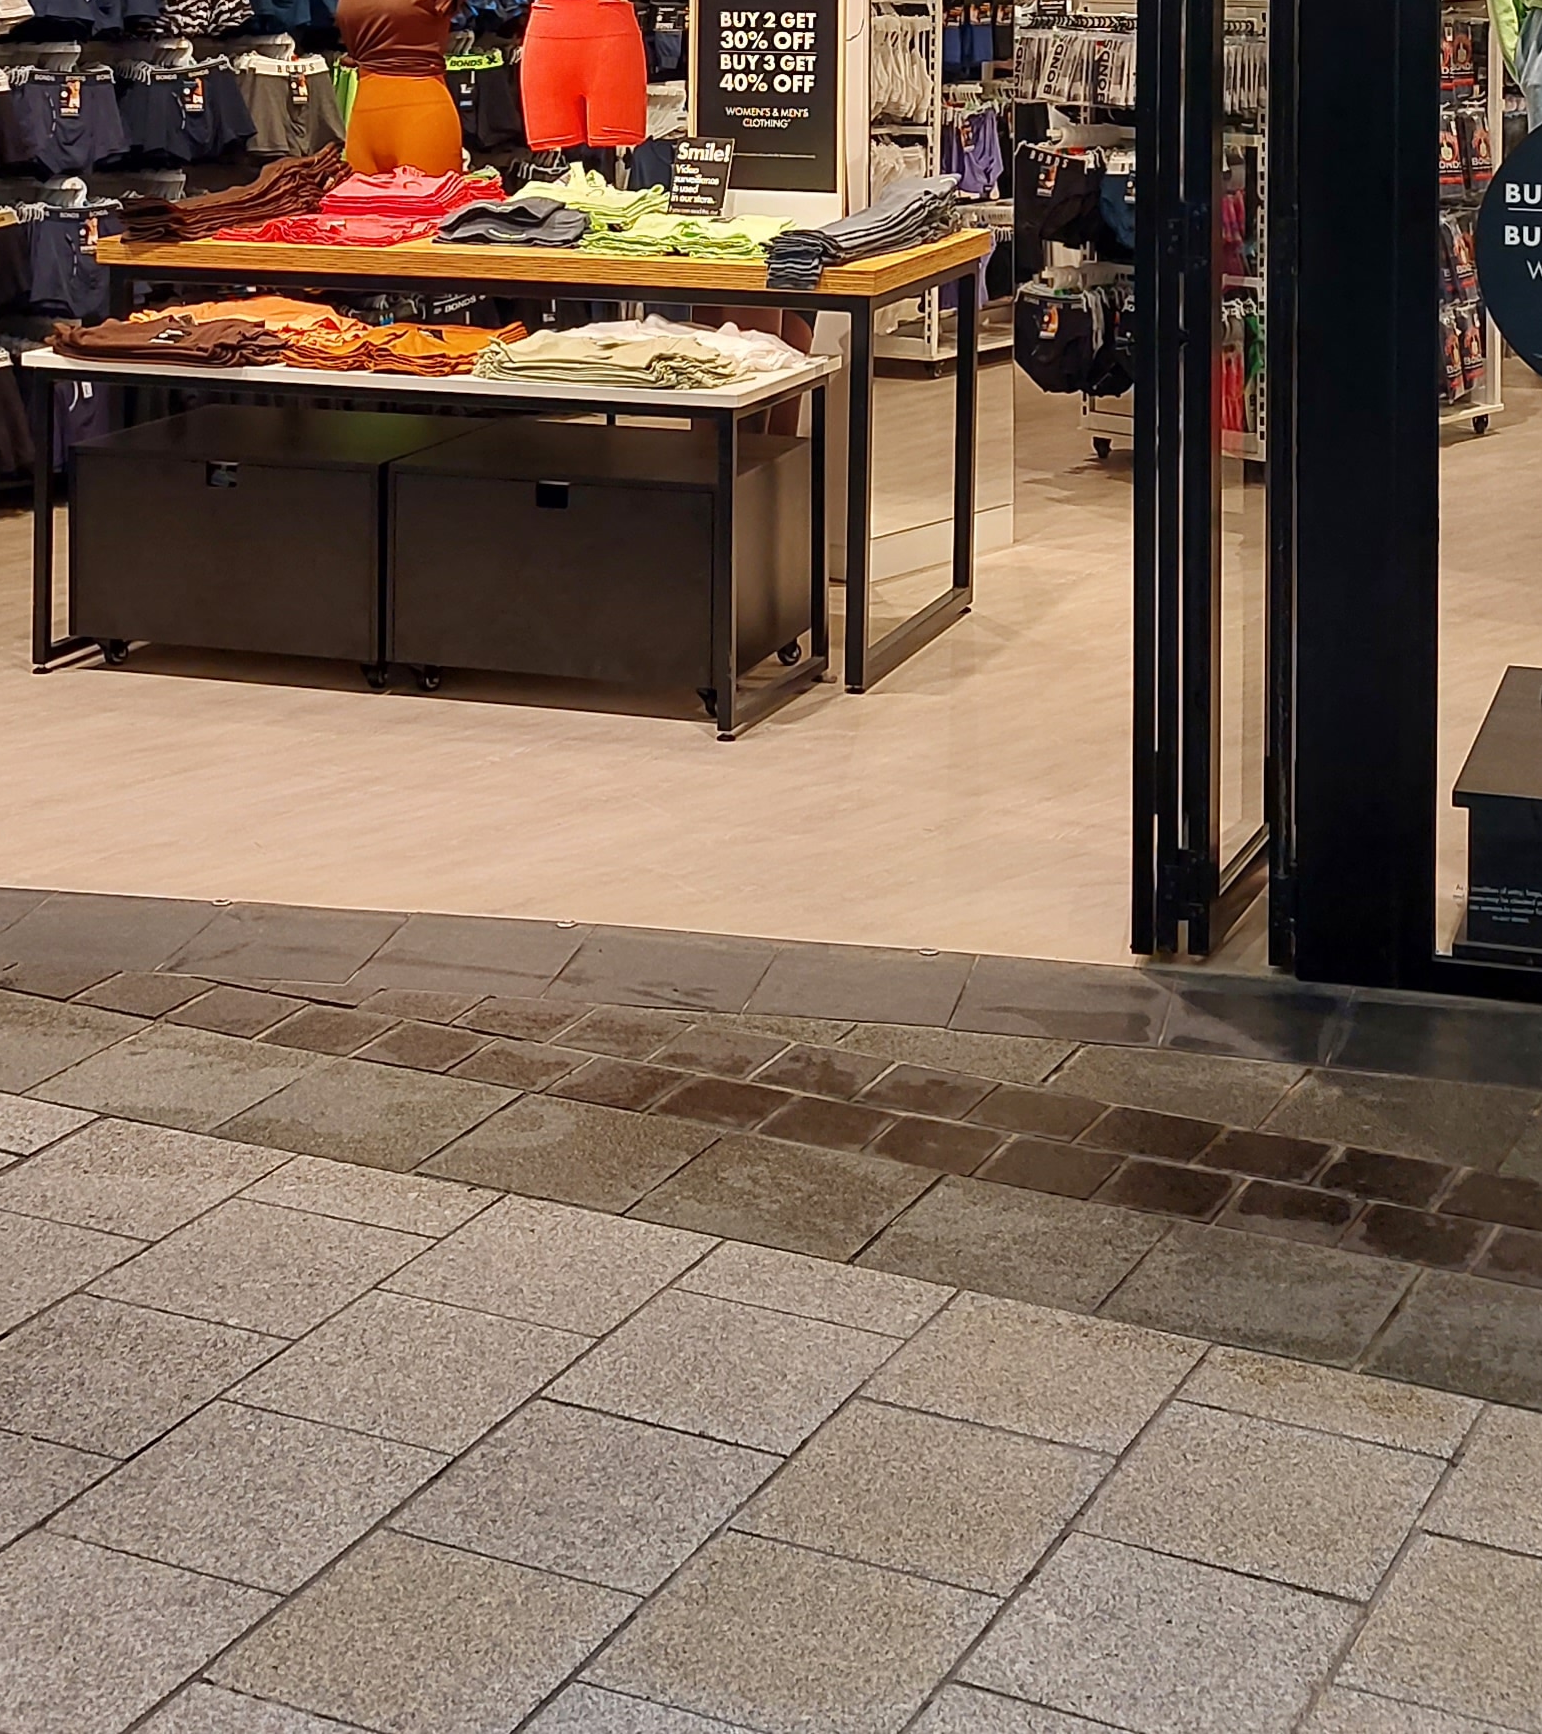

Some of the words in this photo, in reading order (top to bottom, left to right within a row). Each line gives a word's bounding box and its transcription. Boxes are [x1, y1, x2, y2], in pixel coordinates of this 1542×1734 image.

[719, 12, 760, 28] BUY
[763, 13, 777, 28] 2
[780, 13, 817, 29] GET
[720, 31, 768, 50] 30%
[773, 31, 815, 50] OFF
[450, 58, 484, 68] BONDS
[719, 54, 760, 70] BUY
[763, 55, 775, 70] 3
[780, 55, 817, 71] GET
[719, 74, 768, 92] 40%
[773, 75, 815, 93] OFF
[725, 106, 770, 117] WOMEN'S
[772, 108, 779, 117] &
[780, 108, 809, 118] MEN'S
[677, 142, 731, 162] Smile!
[1029, 149, 1069, 168] BONDS
[676, 164, 699, 174] Video
[444, 295, 476, 313] BONDS
